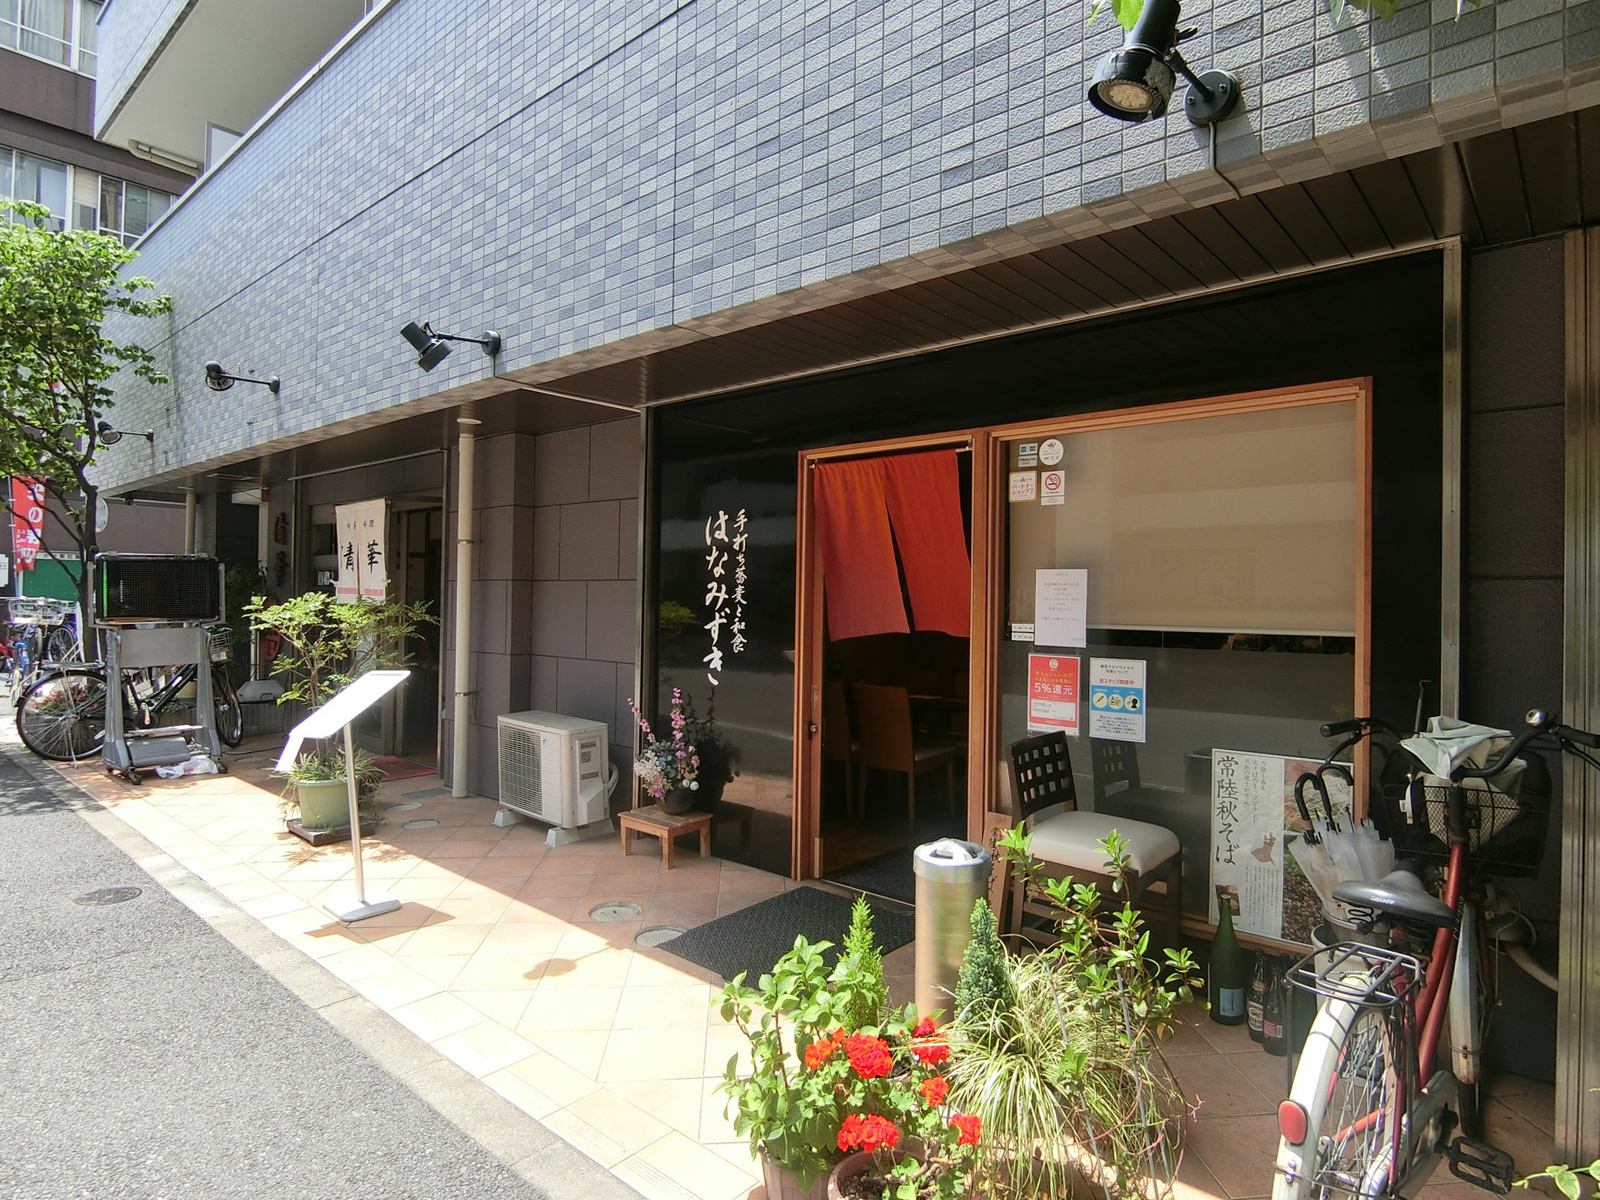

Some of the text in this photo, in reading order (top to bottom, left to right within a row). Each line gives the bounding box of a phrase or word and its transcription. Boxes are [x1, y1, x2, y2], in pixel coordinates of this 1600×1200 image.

[703, 510, 730, 686] はなみずき
[730, 508, 749, 653] 手打ち蕎麦と和食
[1034, 682, 1073, 695] 5%還元
[1215, 755, 1239, 866] 常陸秋そば
